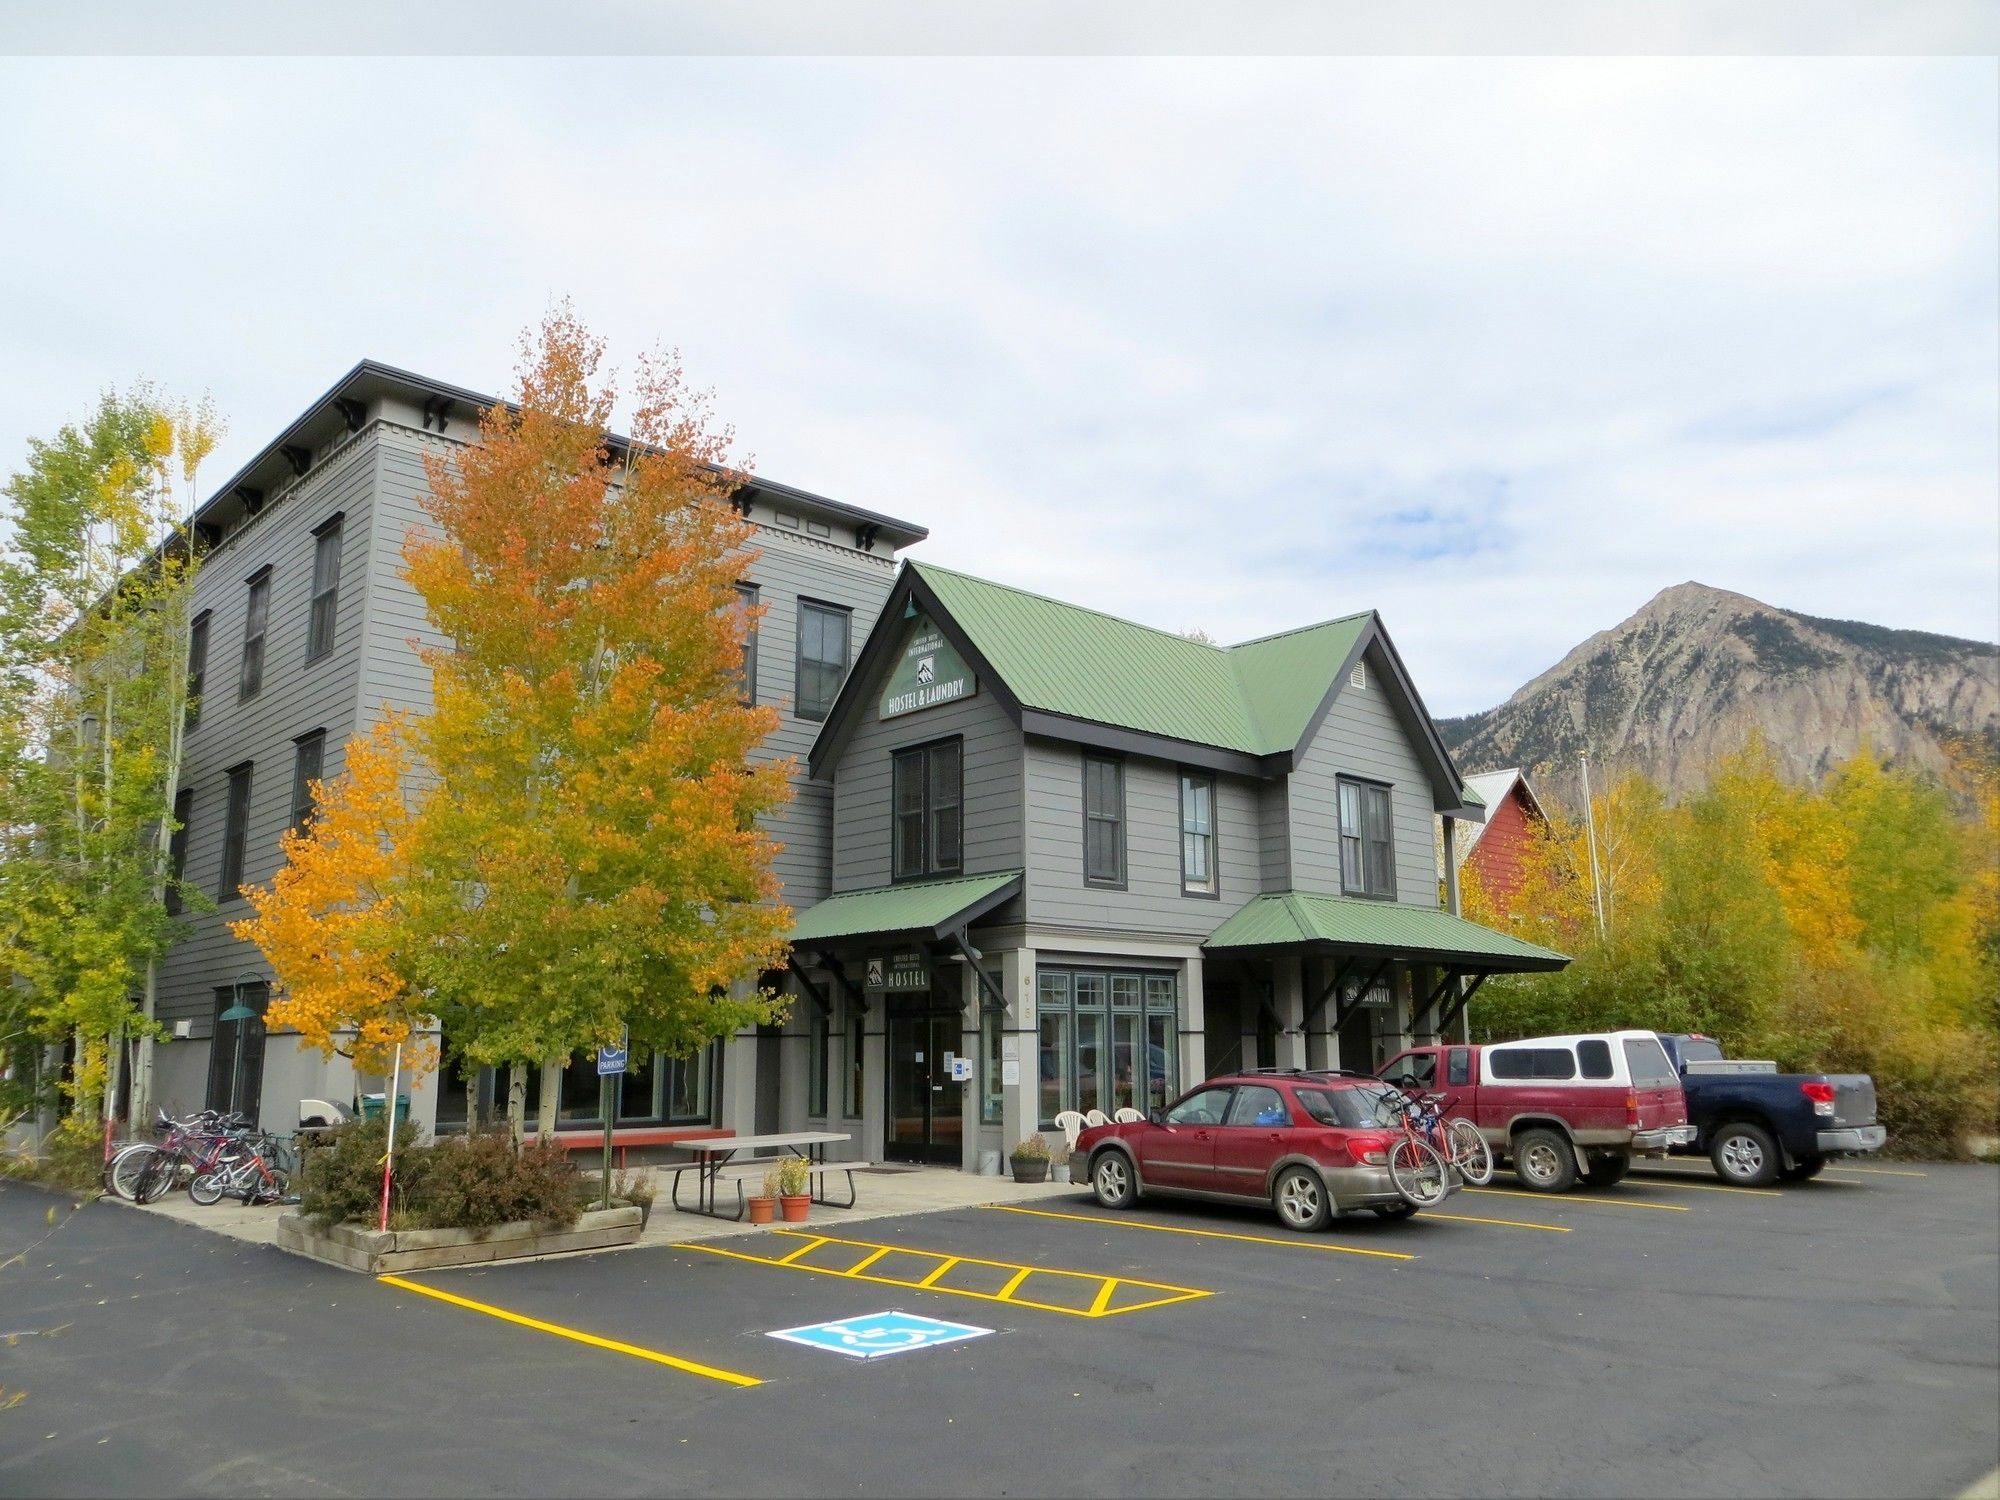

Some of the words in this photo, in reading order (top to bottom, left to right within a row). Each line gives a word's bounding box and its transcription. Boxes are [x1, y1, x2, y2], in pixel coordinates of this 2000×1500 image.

[908, 639, 943, 657] INTERNATIONAL
[889, 692, 917, 714] HOSTEL
[918, 689, 925, 706] &
[926, 678, 964, 704] LAUNDRY
[888, 970, 925, 988] HOSTEL
[1362, 987, 1390, 1003] AUNDRY
[600, 1059, 625, 1070] PARKING
